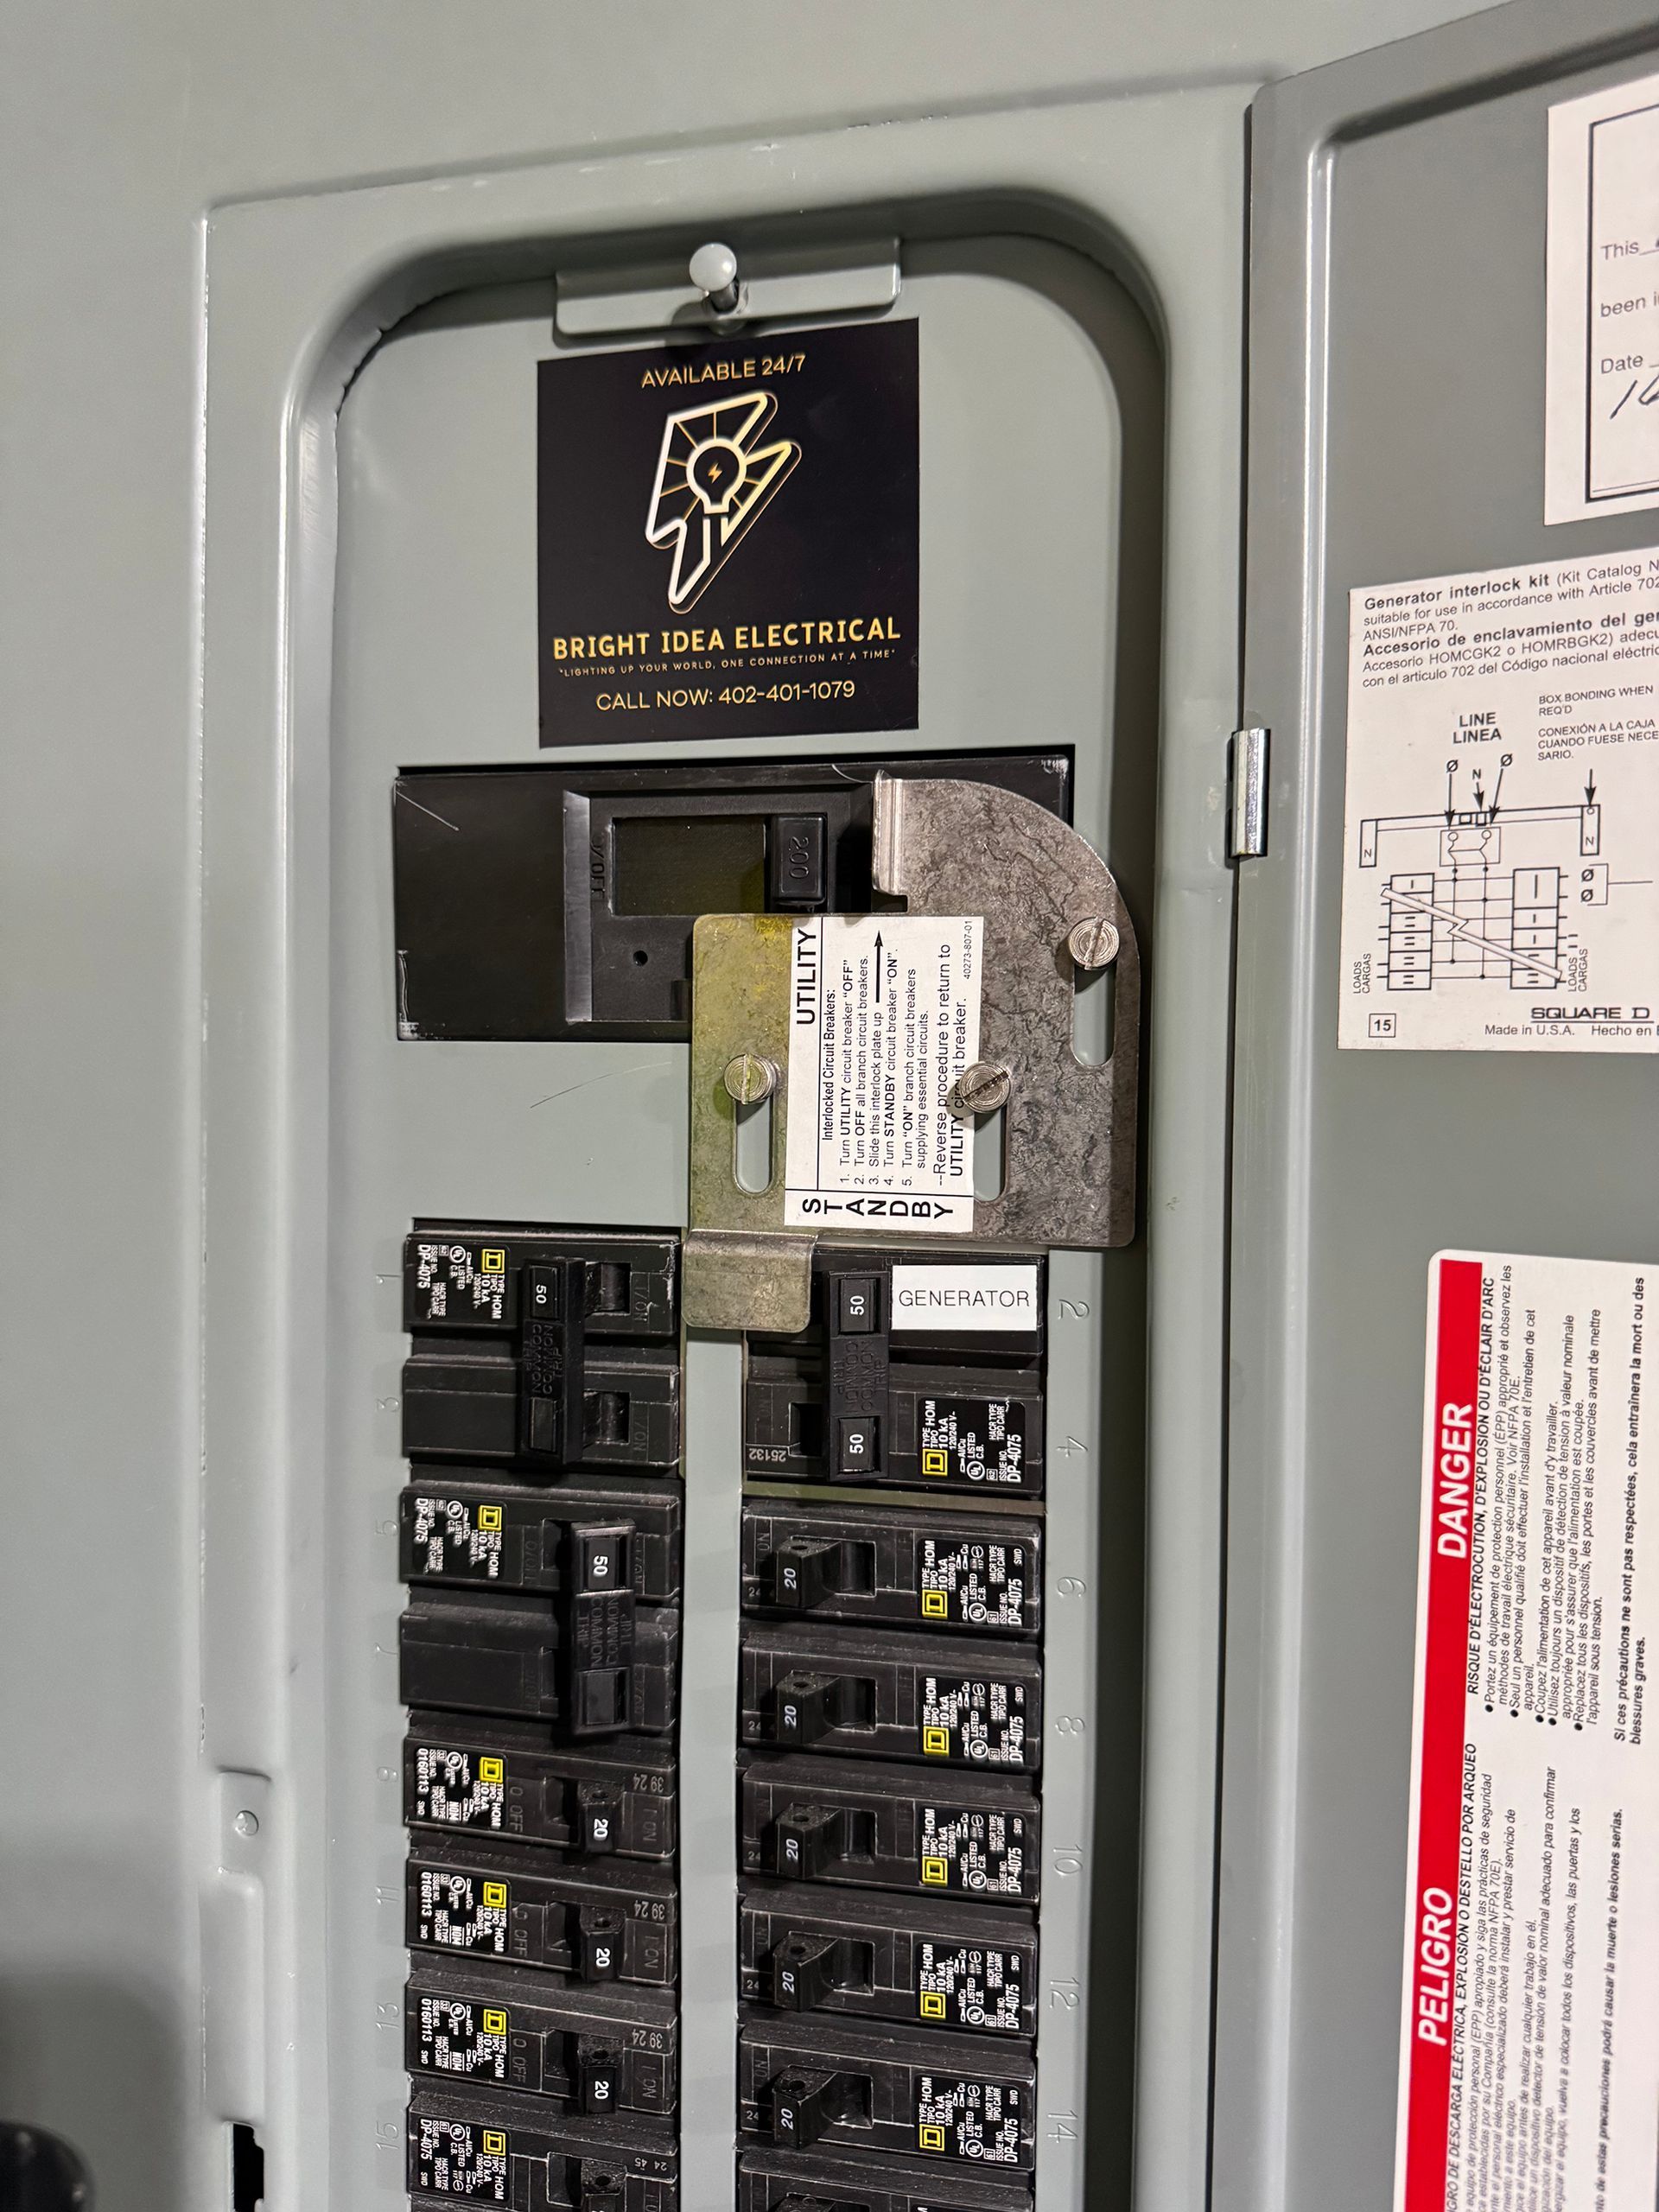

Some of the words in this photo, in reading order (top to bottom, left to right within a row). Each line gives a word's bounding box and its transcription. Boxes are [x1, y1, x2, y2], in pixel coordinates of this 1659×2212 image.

[1600, 240, 1639, 261] This
[1600, 296, 1646, 319] been
[641, 360, 756, 389] AVAILABLE
[761, 353, 806, 376] 24/7
[1601, 353, 1643, 375] Date
[1364, 590, 1443, 610] Generator
[1450, 577, 1521, 599] interlock
[1529, 573, 1549, 588] kit
[1557, 570, 1580, 588] (Kit
[1586, 564, 1642, 581] Catalog
[1363, 611, 1411, 626] suitable
[1414, 607, 1432, 620] for
[1434, 606, 1458, 617] use
[1462, 601, 1473, 613] in
[1477, 593, 1553, 612] accordance
[1557, 587, 1584, 601] with
[1588, 581, 1632, 597] Article
[554, 632, 650, 660] BRIGHT
[661, 628, 725, 653] IDEA
[735, 616, 901, 649] ELECTRICAL
[1363, 622, 1436, 642] ANSI/NFPA
[1439, 619, 1459, 632] 70.
[1363, 637, 1440, 657] Accesorio
[1447, 633, 1466, 647] de
[1473, 619, 1592, 644] enclavamiento
[1600, 612, 1626, 628] del
[620, 664, 634, 674] UP
[639, 663, 668, 672] YOUR
[672, 660, 715, 671] WORLD,
[721, 658, 744, 669] ONE
[749, 653, 825, 667] CONNECTION
[830, 652, 844, 662] AT
[849, 652, 856, 660] A
[1363, 655, 1424, 673] Accesorio
[1429, 645, 1501, 665] HOMCGK2
[1507, 645, 1516, 656] o
[1522, 632, 1613, 654] HOMRBGK2)
[1362, 677, 1384, 688] con
[1388, 673, 1399, 685] el
[1451, 664, 1475, 678] 702
[1478, 662, 1497, 675] del
[1501, 658, 1548, 672] Código
[1552, 649, 1608, 667] nacional
[596, 691, 651, 711] CALL
[657, 688, 713, 708] NOW:
[718, 680, 855, 704] 402-401-1079
[1539, 694, 1562, 705] BOX
[1564, 688, 1617, 702] BONDING
[1618, 684, 1654, 697] WHEN
[1459, 711, 1497, 728] LINE
[1538, 704, 1573, 716] REQ'D
[1452, 728, 1502, 744] LINEA
[1538, 722, 1597, 738] CONEXIÓN
[1598, 722, 1607, 733] A
[1609, 721, 1624, 732] LA
[1625, 718, 1656, 730] CAJA
[1537, 736, 1586, 750] CUANDO
[1587, 733, 1624, 745] FUESE
[1537, 749, 1573, 761] SARIO.
[789, 836, 809, 880] 200
[938, 944, 950, 959] to
[963, 920, 973, 980] 40273-807-01
[796, 928, 817, 1025] UTILITY
[856, 956, 868, 1009] breakers.
[1353, 961, 1362, 995] LOADS
[1362, 953, 1372, 994] CARGAS
[1567, 957, 1578, 992] LOADS
[1578, 949, 1588, 992] CARGAS
[905, 969, 916, 1020] breakers
[937, 963, 950, 1007] return
[823, 989, 836, 1040] Breakers:
[842, 1001, 853, 1046] breaker
[874, 1012, 884, 1027] up
[886, 988, 897, 1033] breaker
[937, 1013, 950, 1027] to
[1531, 1007, 1622, 1020] SQUARE
[1631, 1007, 1650, 1020] D
[856, 1013, 868, 1047] circuit
[917, 1010, 929, 1055] circuits.
[952, 998, 967, 1059] breaker.
[1374, 1019, 1391, 1032] 15
[1484, 1024, 1518, 1035] Made
[1522, 1024, 1532, 1035] in
[1536, 1024, 1575, 1036] U.S.A.
[1591, 1025, 1632, 1036] Hecho
[1636, 1027, 1652, 1036] en
[871, 1030, 884, 1058] plate
[885, 1036, 896, 1071] circuit
[904, 1023, 915, 1058] circuit
[823, 1043, 835, 1078] Circuit
[841, 1049, 852, 1084] circuit
[855, 1050, 867, 1090] branch
[935, 1031, 951, 1108] procedure
[869, 1062, 881, 1111] interlock
[903, 1061, 914, 1102] branch
[916, 1058, 928, 1110] essential
[822, 1081, 834, 1141] Interlocked
[840, 1087, 851, 1135] UTILITY
[855, 1094, 866, 1107] all
[884, 1074, 895, 1137] STANDBY
[855, 1110, 866, 1136] OFF
[869, 1114, 880, 1135] this
[839, 1139, 850, 1166] Turn
[854, 1140, 865, 1166] Turn
[868, 1138, 880, 1167] Slide
[883, 1141, 894, 1167] Turn
[915, 1113, 929, 1169] supplying
[950, 1114, 963, 1176] UTILITY
[901, 1141, 912, 1168] Turn
[839, 1173, 849, 1183] 1.
[854, 1174, 865, 1185] 2.
[868, 1175, 880, 1185] 3.
[883, 1175, 893, 1186] 4.
[901, 1176, 912, 1186] 5.
[803, 1198, 954, 1219] STANDBY
[535, 1284, 547, 1305] 50
[849, 1295, 865, 1317] 50
[899, 1290, 1030, 1307] GENERATOR
[925, 1401, 937, 1427] HOM
[938, 1417, 949, 1432] kA
[849, 1433, 864, 1454] 50
[922, 1427, 931, 1447] TYPE
[938, 1433, 949, 1448] 10
[967, 1432, 976, 1458] LISTED
[1007, 1433, 1022, 1483] DP-4075
[1437, 1402, 1473, 1558] DANGER
[592, 1555, 608, 1577] 50
[784, 1567, 798, 1589] 20
[784, 1704, 798, 1727] 20
[594, 1819, 608, 1840] 20
[785, 1837, 799, 1859] 20
[595, 1948, 610, 1968] 20
[1418, 1886, 1452, 2046] PELIGRO
[782, 1971, 795, 1991] 20
[594, 2081, 609, 2100] 20
[781, 2107, 794, 2129] 20
